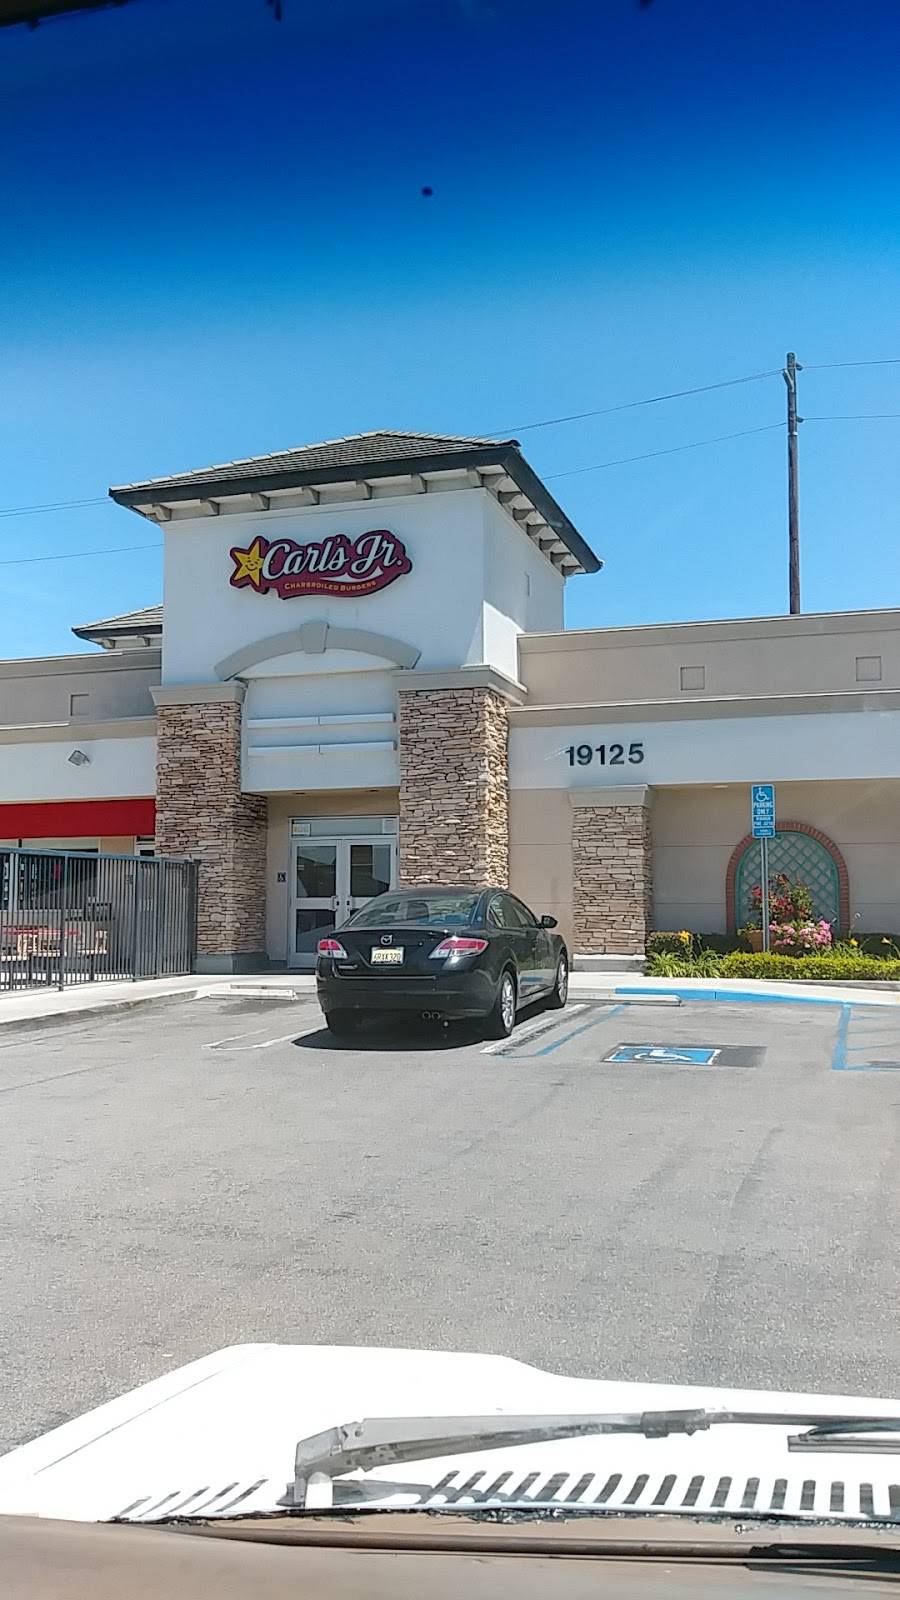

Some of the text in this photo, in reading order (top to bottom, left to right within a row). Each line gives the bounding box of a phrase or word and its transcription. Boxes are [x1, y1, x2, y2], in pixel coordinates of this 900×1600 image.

[262, 535, 402, 580] Carl's Jr.
[565, 743, 644, 766] 19125
